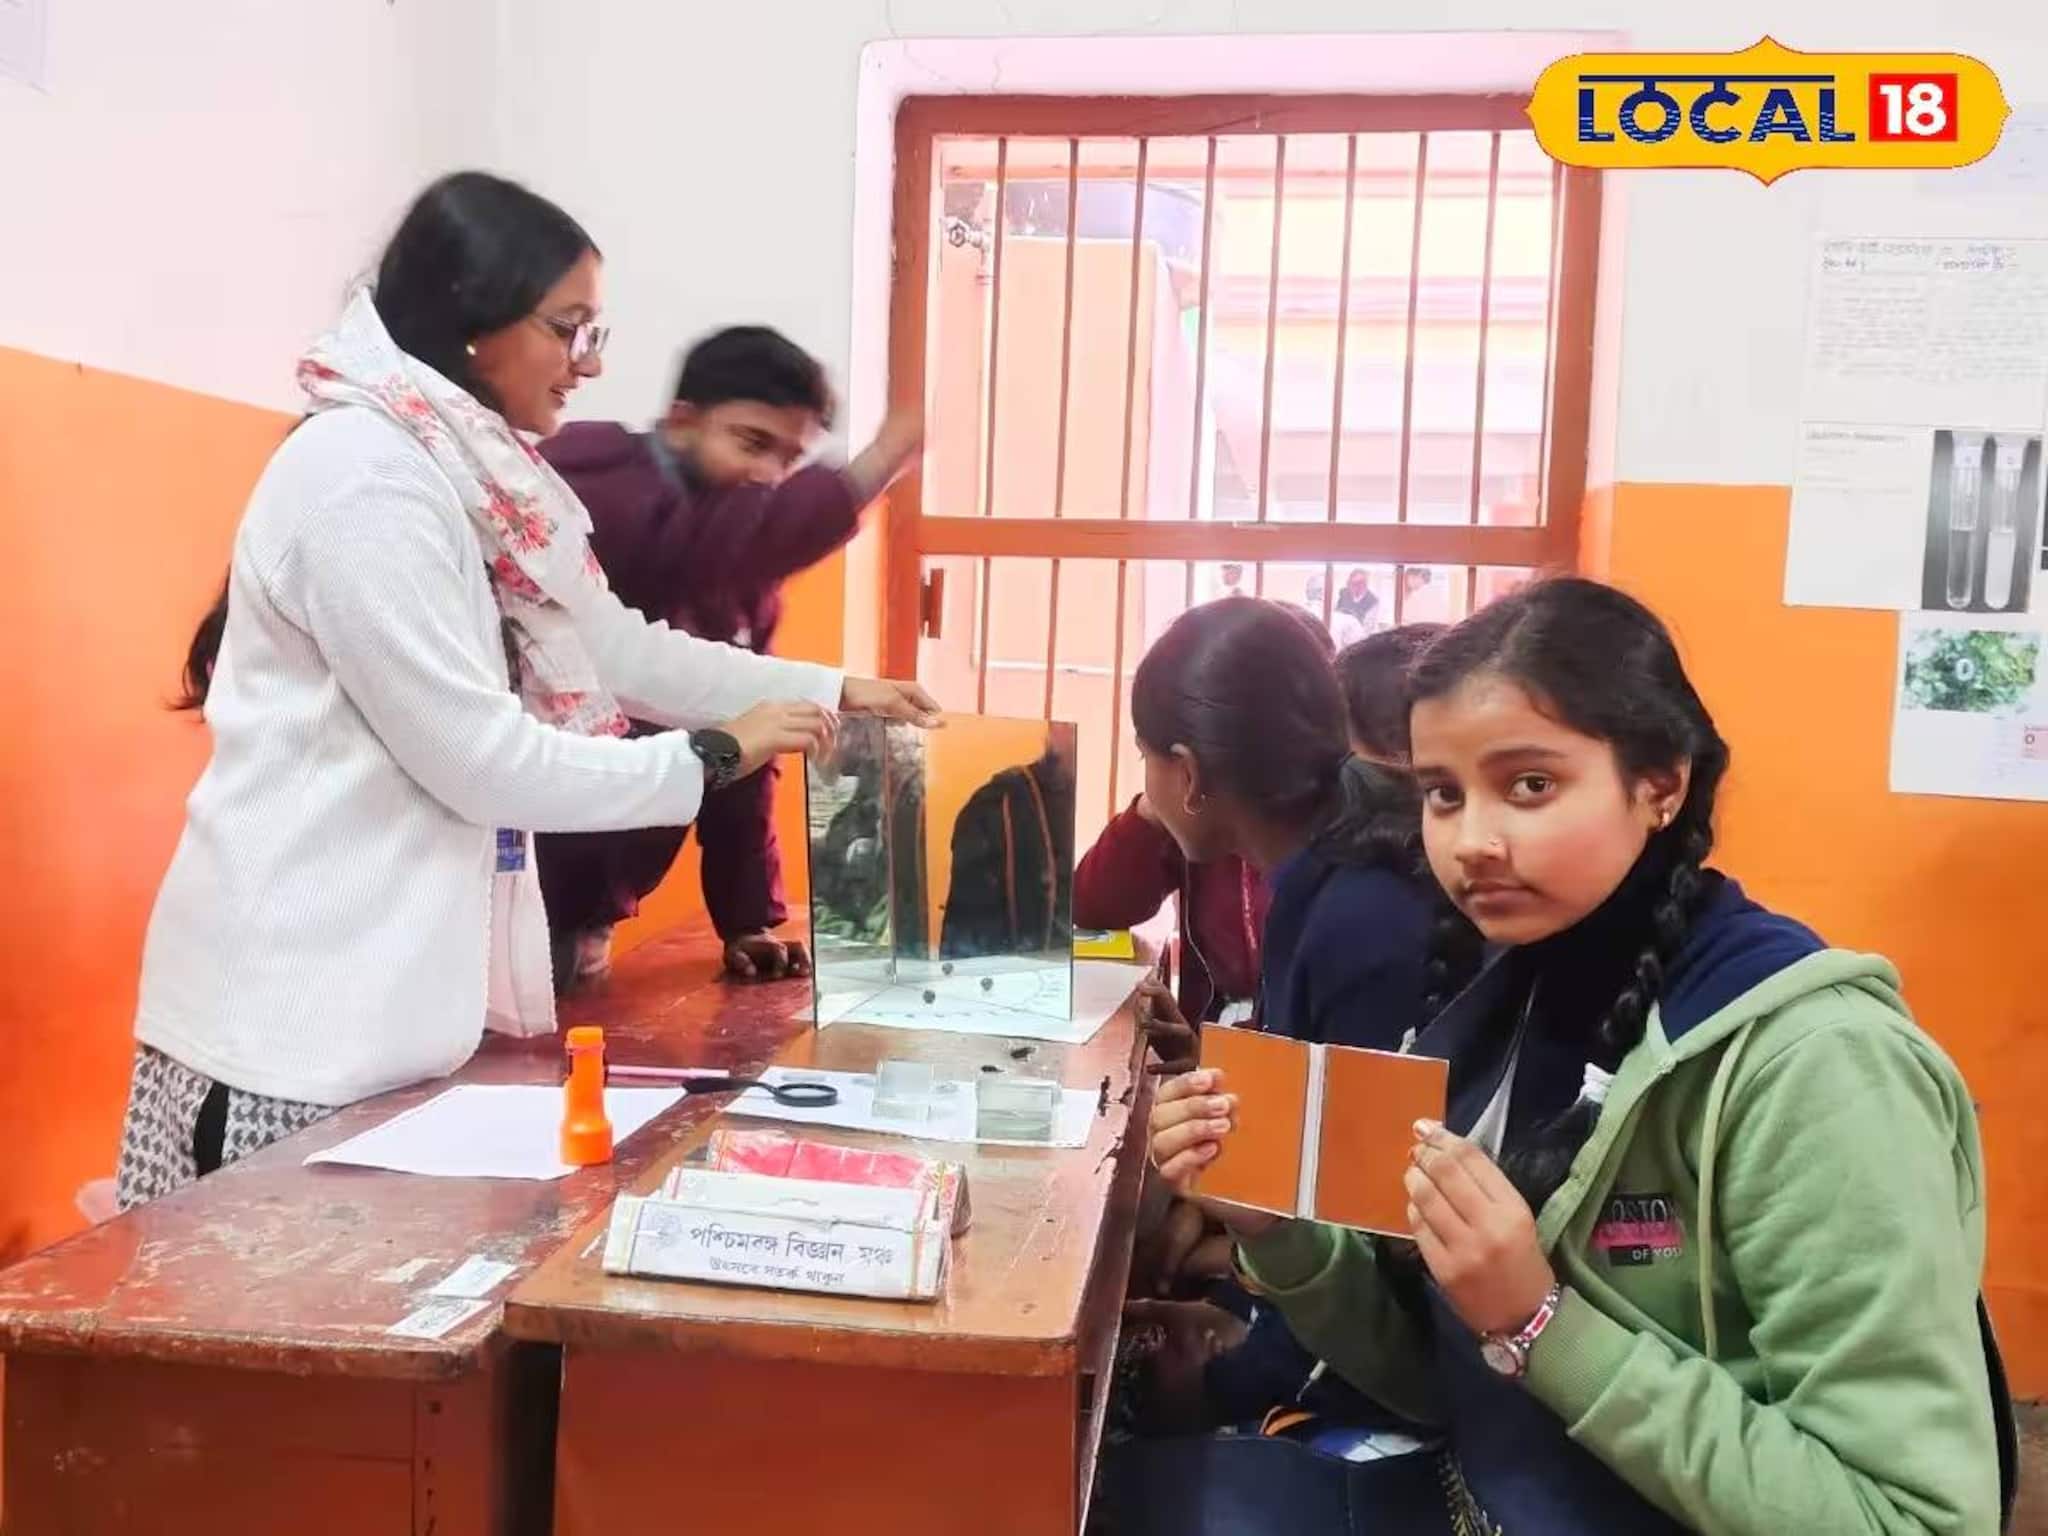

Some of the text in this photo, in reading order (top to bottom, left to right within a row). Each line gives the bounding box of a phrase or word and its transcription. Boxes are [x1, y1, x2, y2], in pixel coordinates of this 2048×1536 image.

[690, 1223, 779, 1256] পশ্চিমবঙ্গ
[785, 1231, 845, 1263] বিজ্ঞান
[806, 1270, 846, 1286] থাকুন
